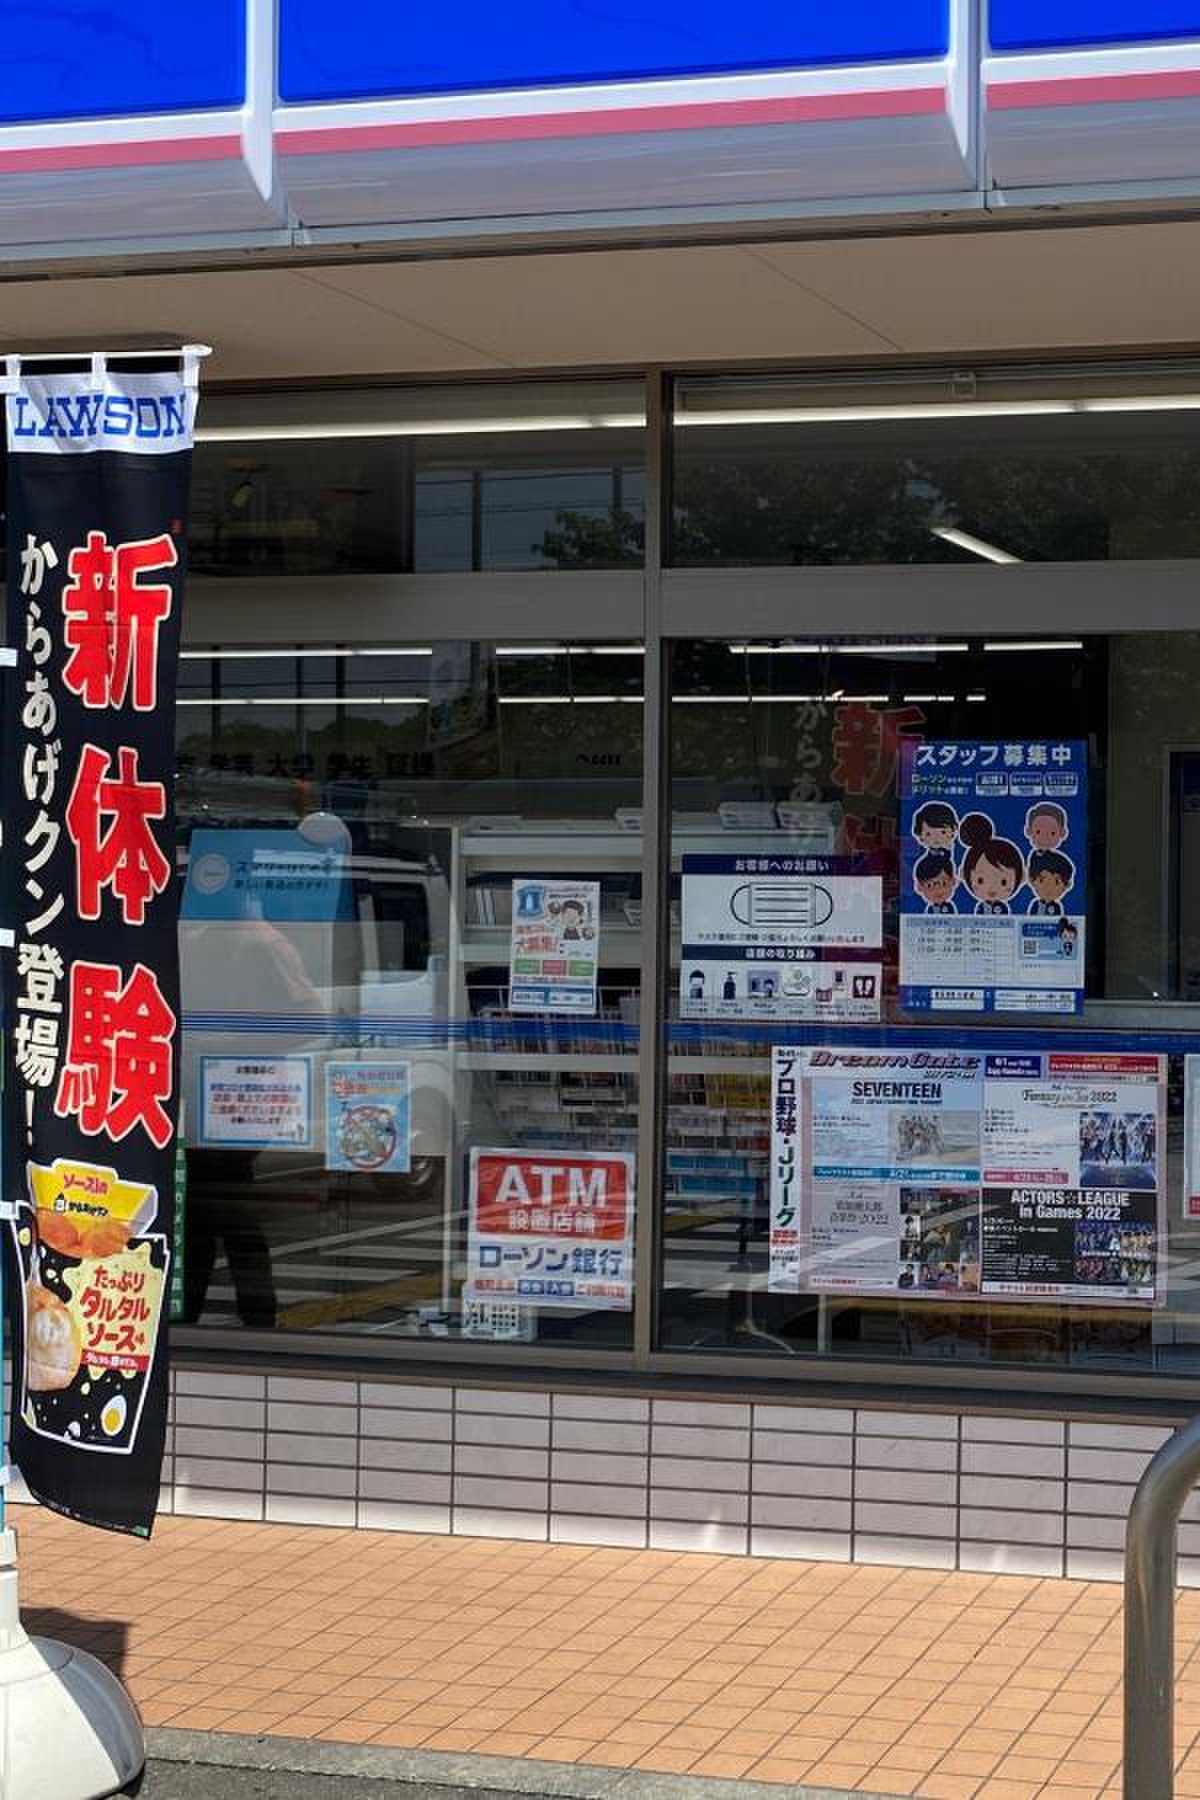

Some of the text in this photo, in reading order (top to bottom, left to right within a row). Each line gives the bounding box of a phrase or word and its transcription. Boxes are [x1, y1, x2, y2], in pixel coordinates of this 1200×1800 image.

[14, 396, 187, 438] LAWSON
[916, 744, 1072, 766] スタッフ募集中
[53, 531, 177, 1149] 新体験
[852, 1081, 942, 1099] SEVENTEEN
[495, 1164, 608, 1208] ATM
[509, 1208, 596, 1233] 設置店舗
[1037, 1205, 1083, 1219] Games
[1086, 1206, 1121, 1221] 2022
[479, 1245, 623, 1276] ローソン銀行
[93, 1264, 145, 1293] たっぷり
[80, 1286, 151, 1322] タルタル
